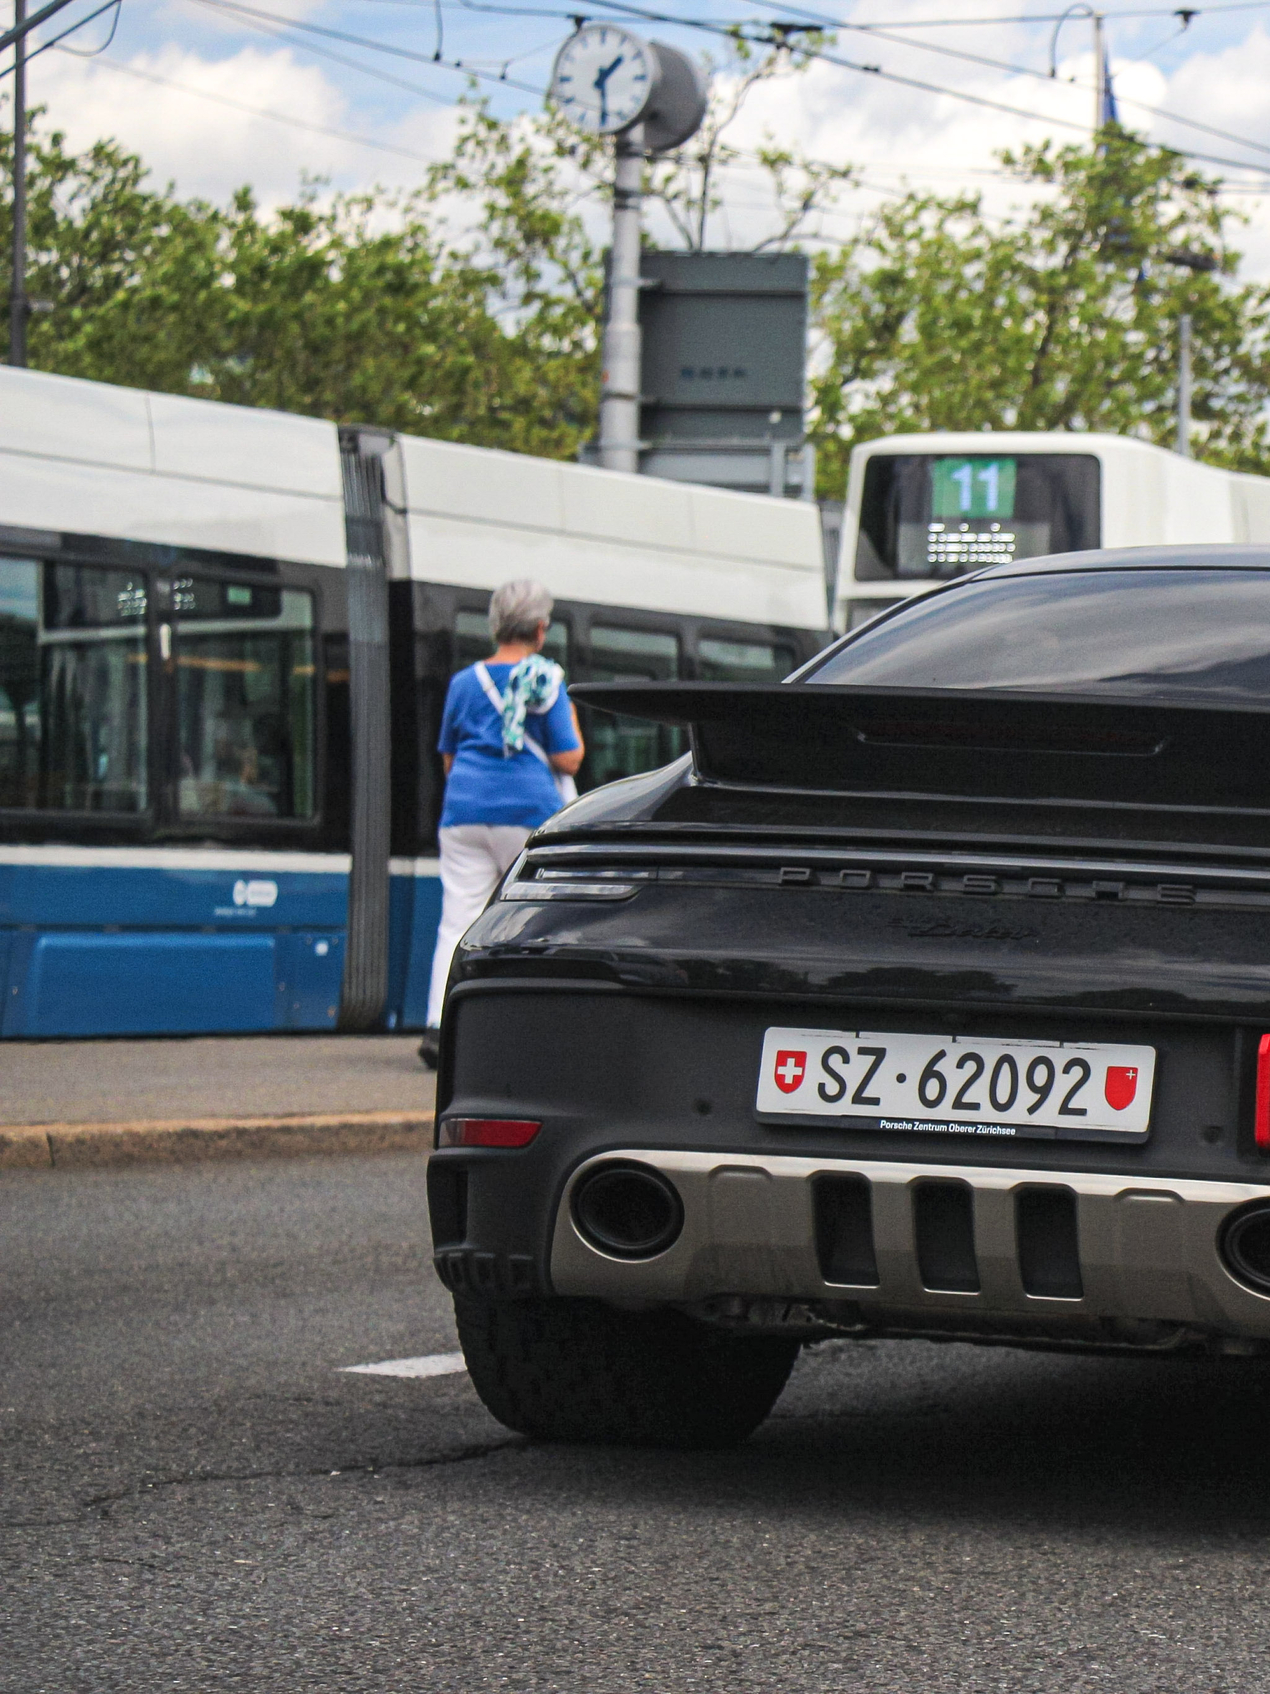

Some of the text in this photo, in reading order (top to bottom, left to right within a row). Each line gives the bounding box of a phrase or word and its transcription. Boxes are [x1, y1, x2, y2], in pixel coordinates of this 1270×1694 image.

[952, 463, 999, 512] 11
[779, 866, 1197, 905] PORSCHE
[880, 1119, 1016, 1136] Porsche Zentrum Oberer Zürichsee
